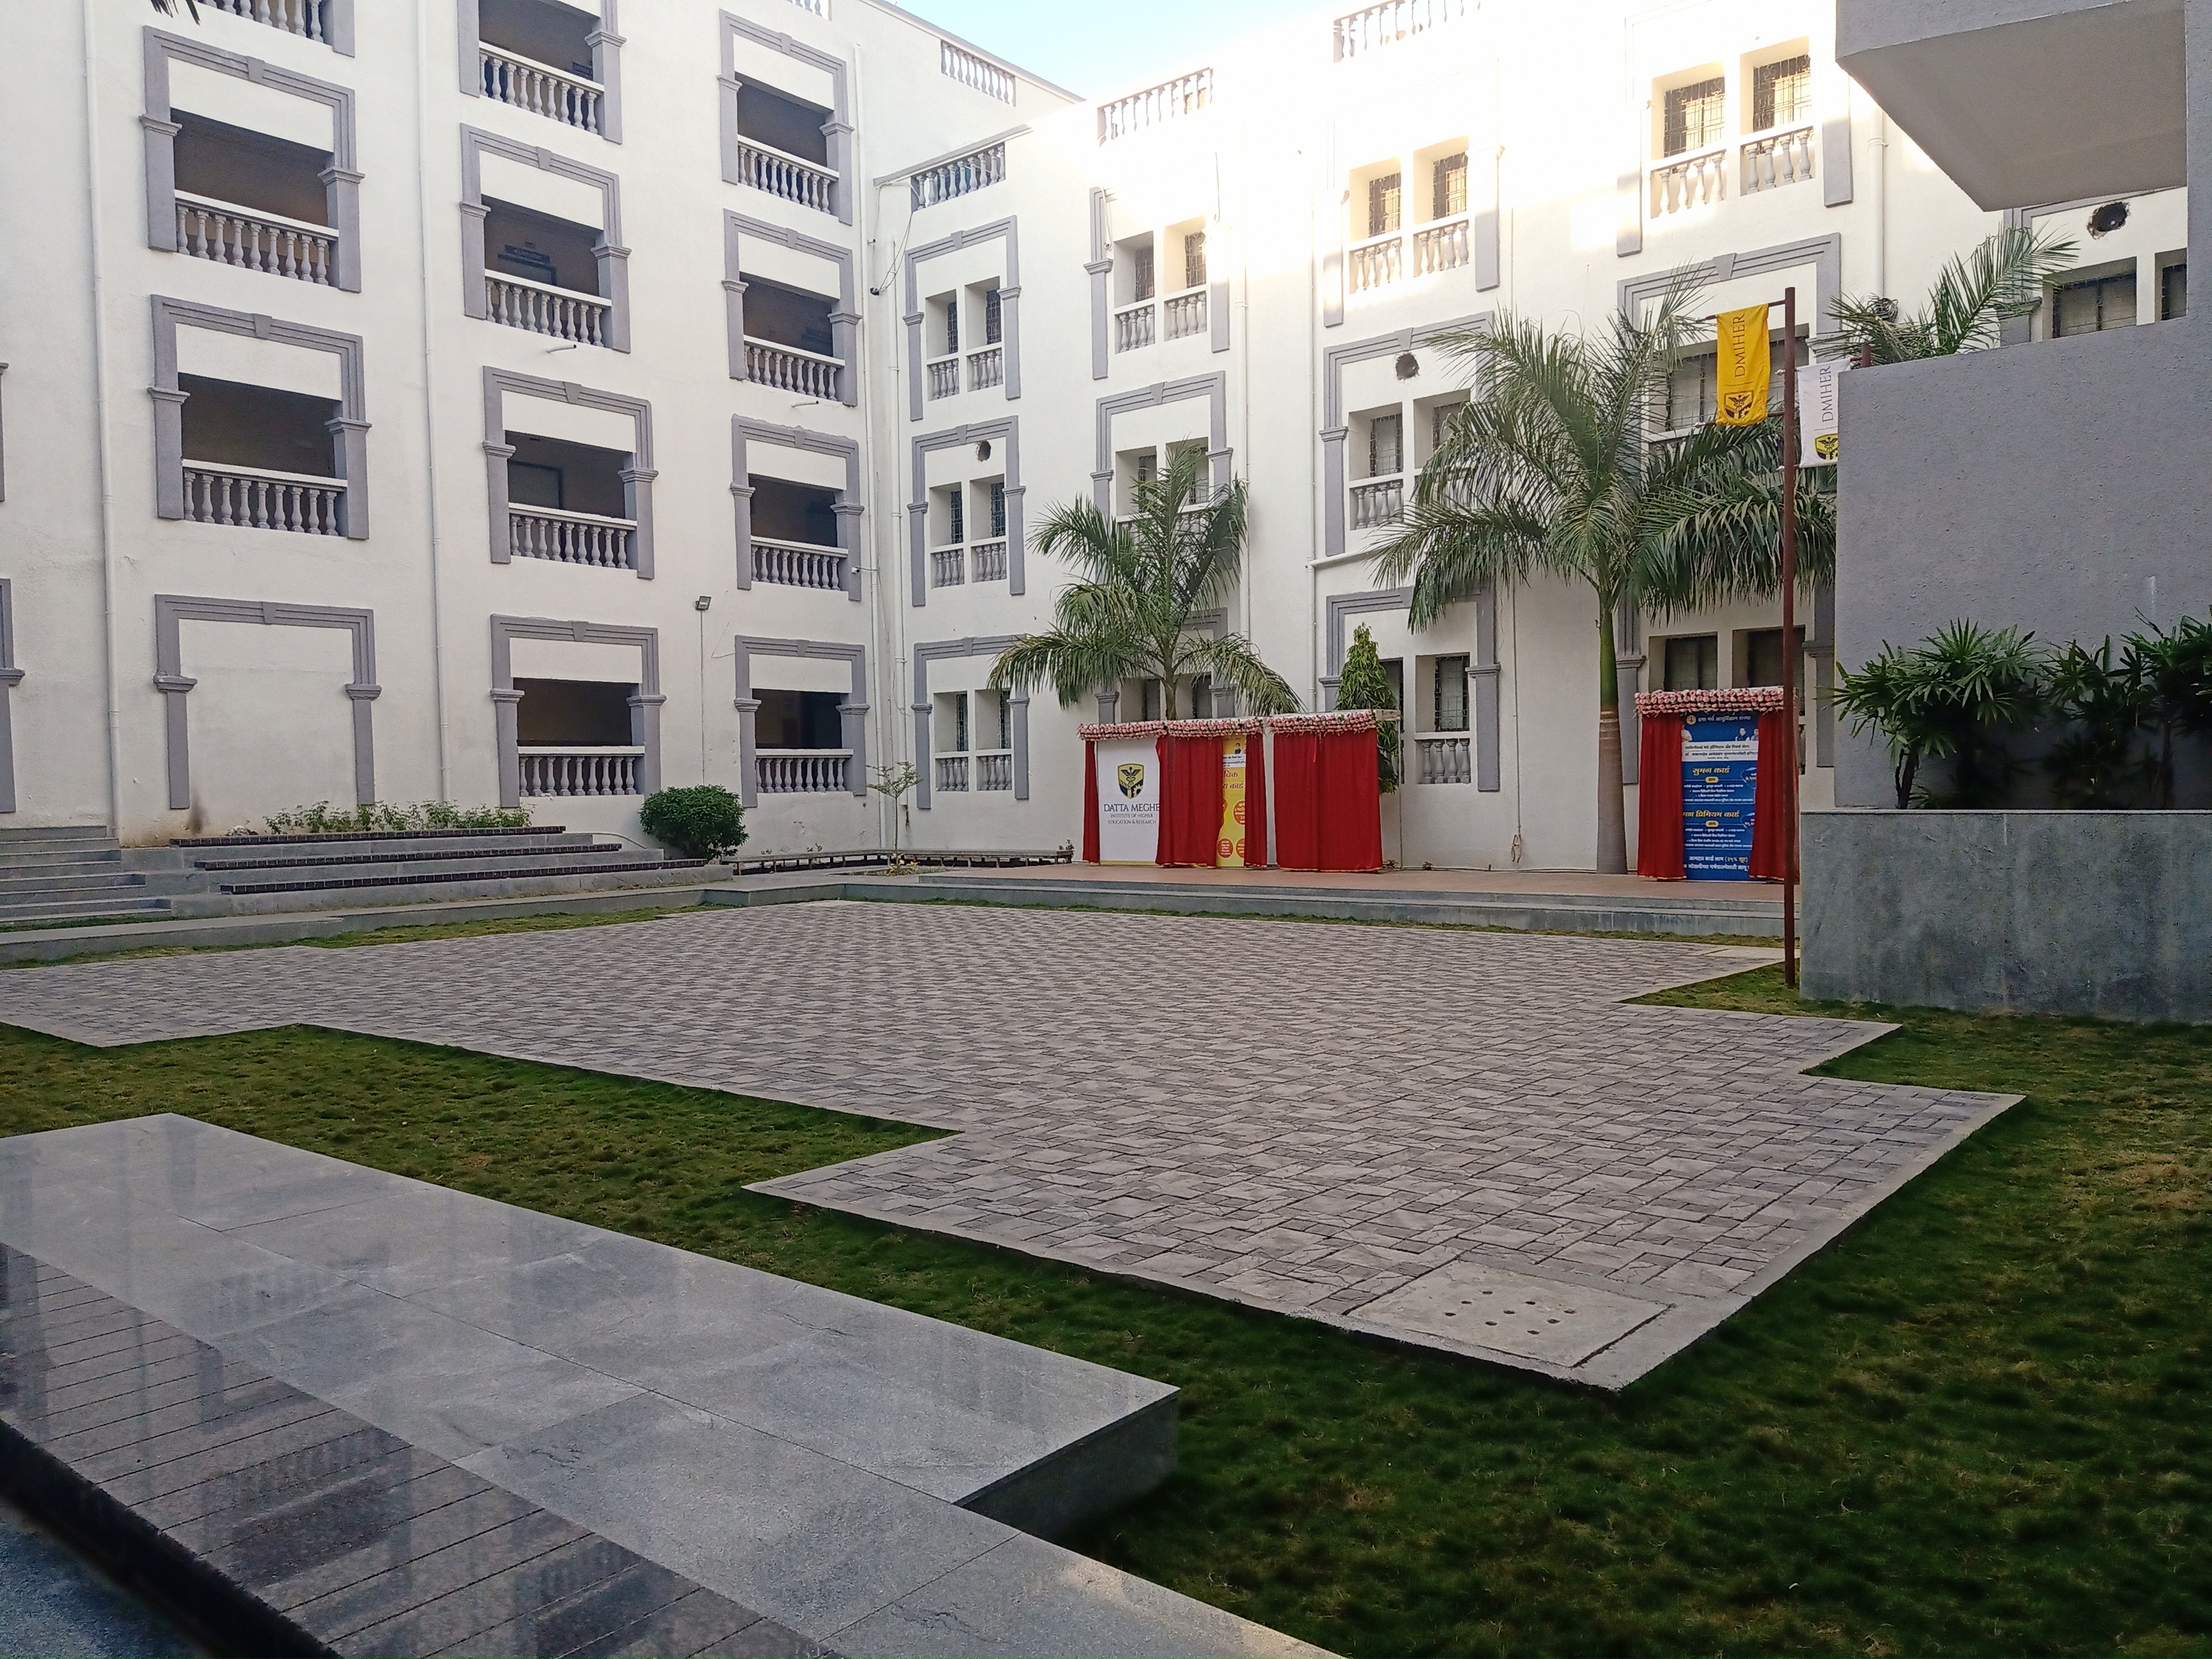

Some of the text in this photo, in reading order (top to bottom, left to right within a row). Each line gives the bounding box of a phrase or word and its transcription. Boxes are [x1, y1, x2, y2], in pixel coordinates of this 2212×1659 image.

[1733, 314, 1745, 378] DMIHER
[1819, 365, 1833, 422] DMIHER
[1131, 804, 1160, 812] MEGHE
